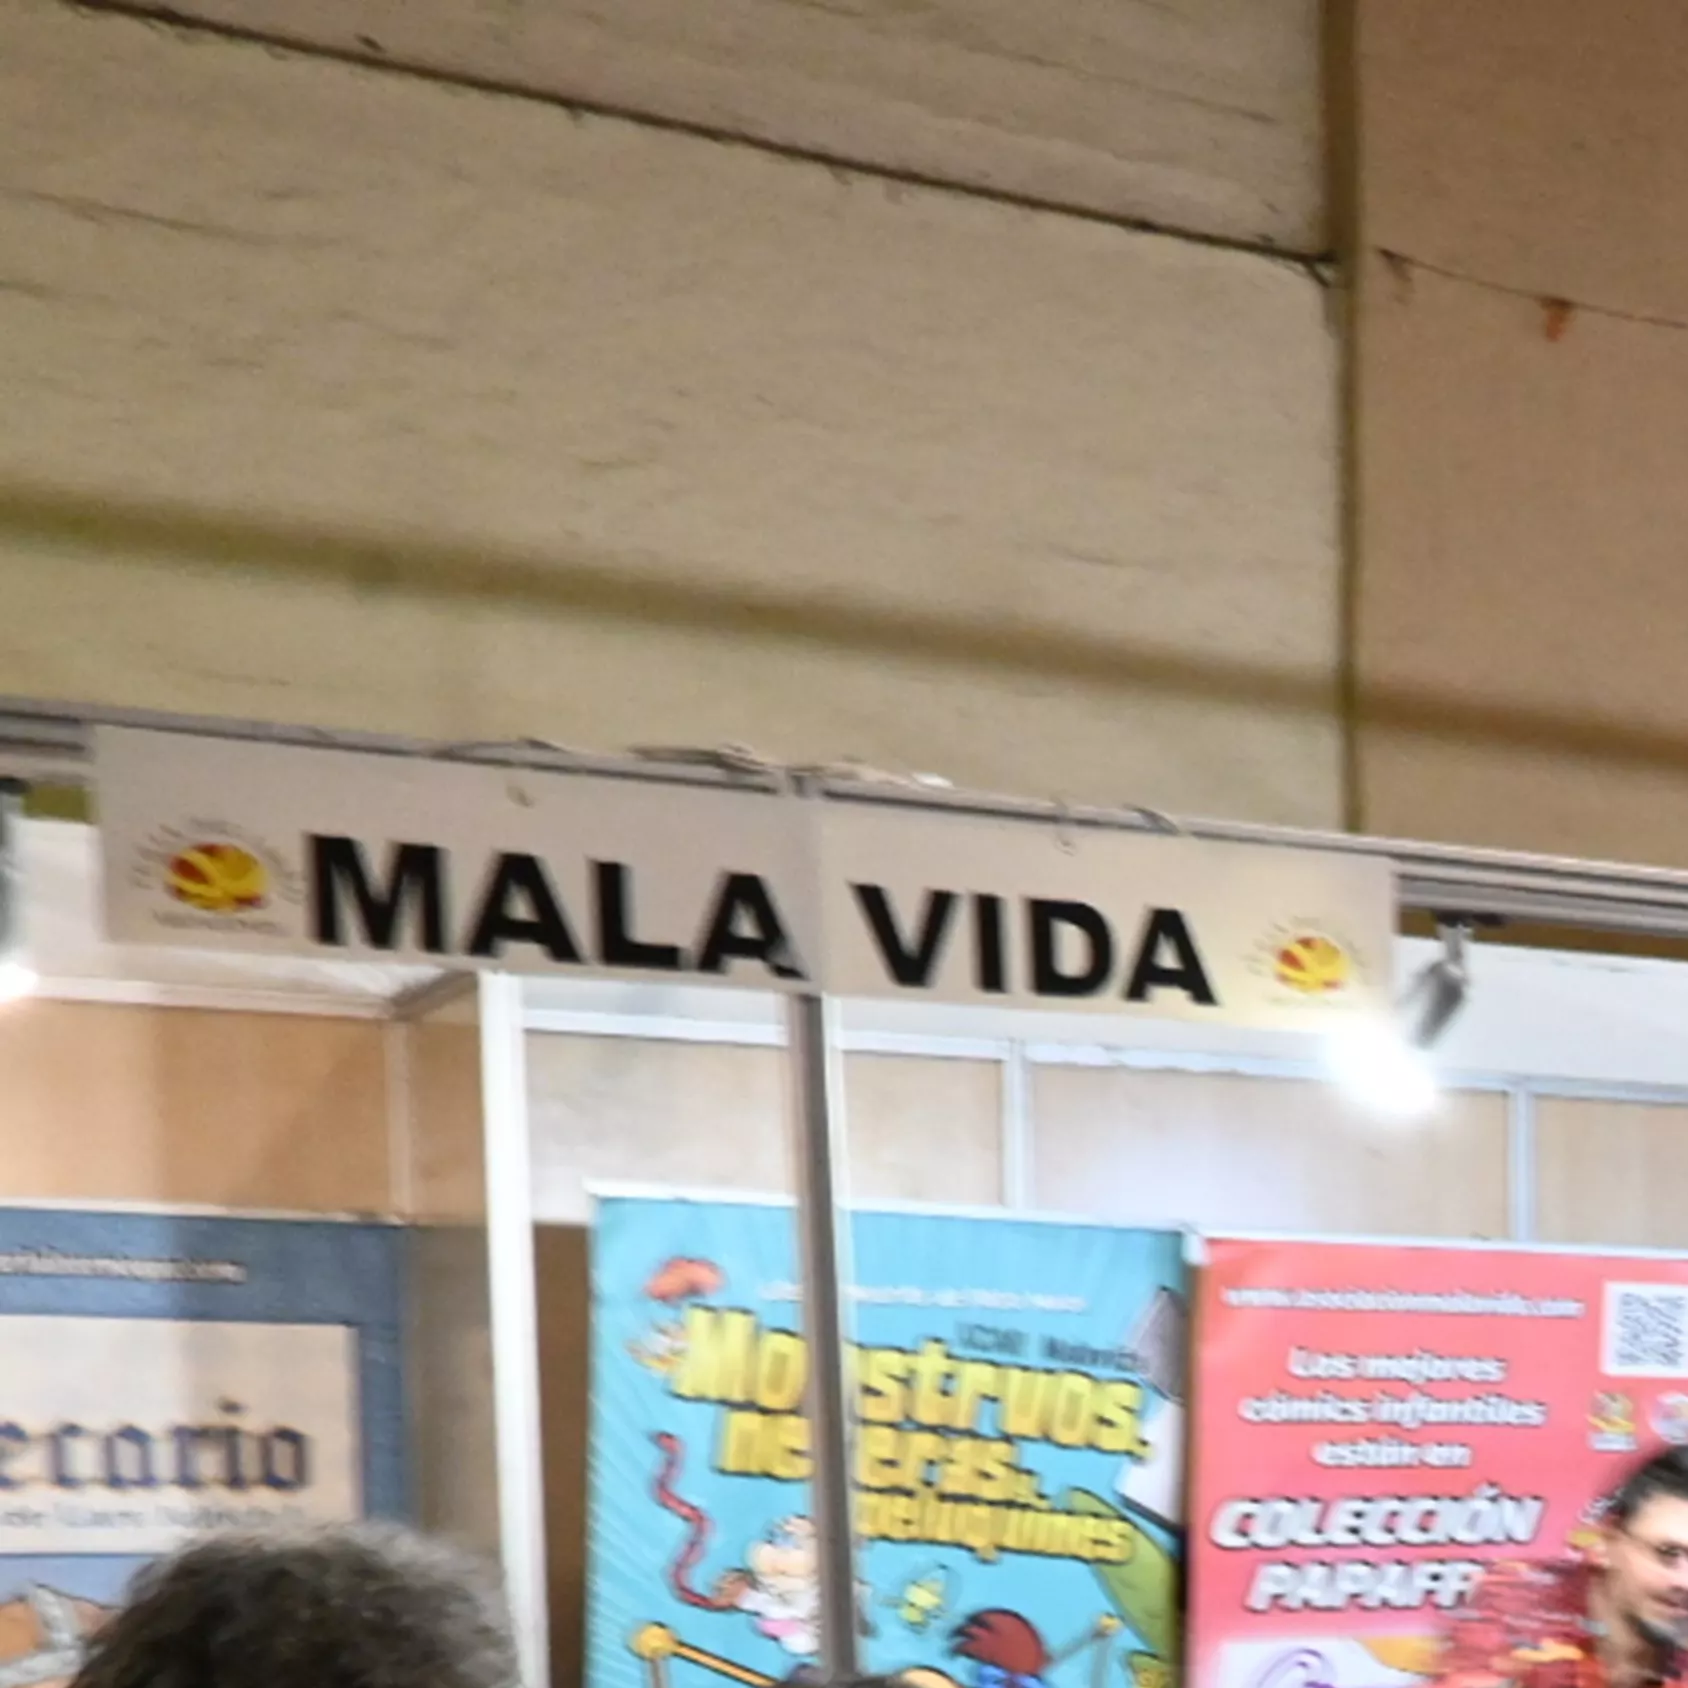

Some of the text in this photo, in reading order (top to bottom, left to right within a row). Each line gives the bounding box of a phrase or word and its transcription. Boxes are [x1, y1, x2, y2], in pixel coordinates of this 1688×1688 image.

[305, 832, 811, 982] MALA
[846, 881, 1221, 1007] VIDA
[1361, 1348, 1509, 1385] mejores
[1373, 1390, 1550, 1430] infantiles
[1208, 1481, 1545, 1550] COLECCIÓN
